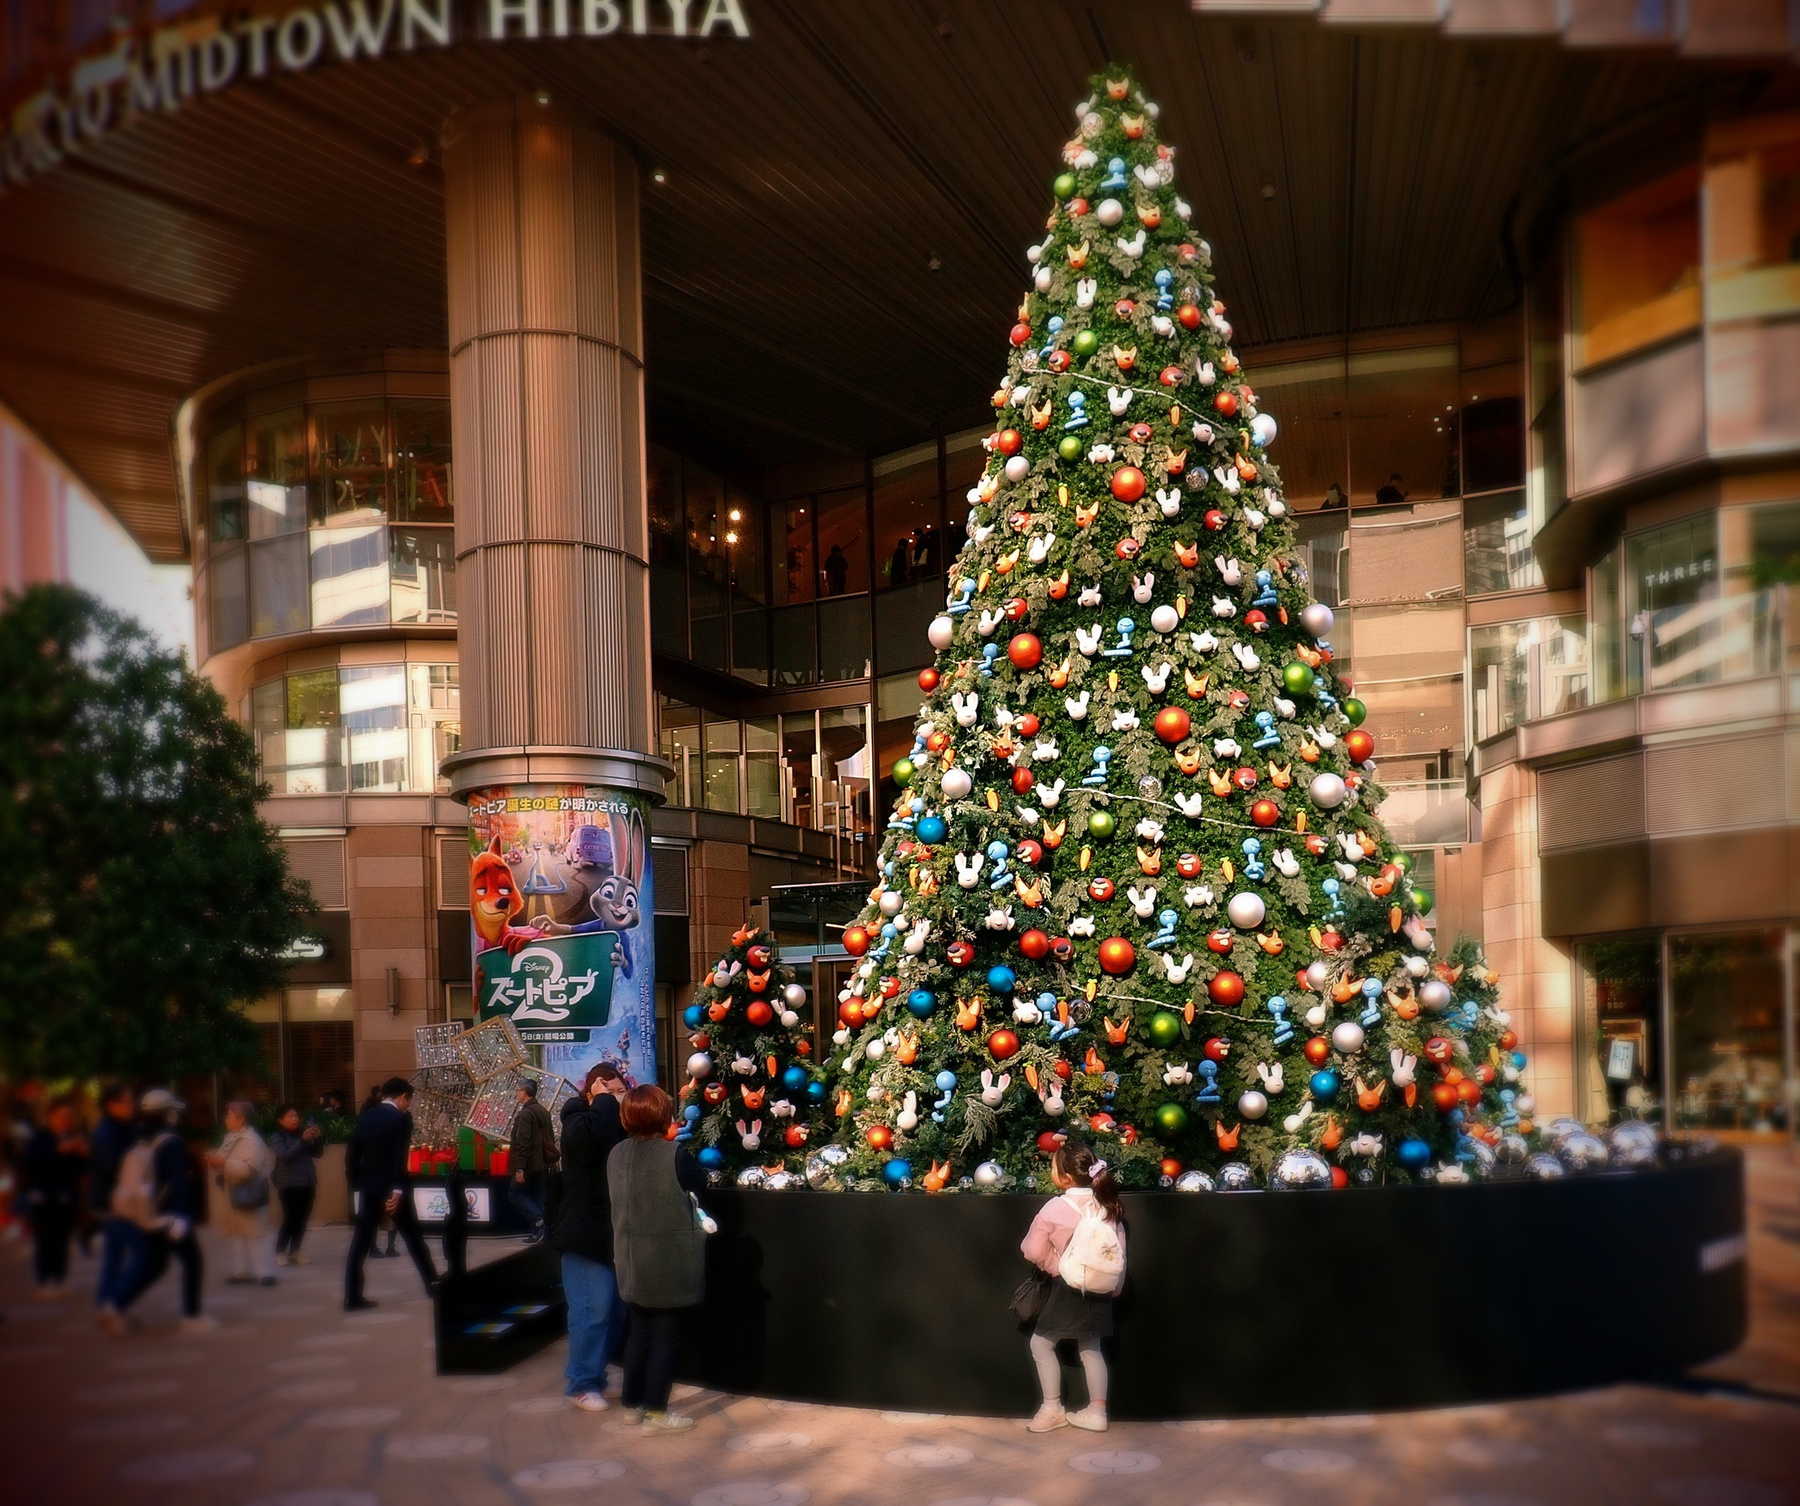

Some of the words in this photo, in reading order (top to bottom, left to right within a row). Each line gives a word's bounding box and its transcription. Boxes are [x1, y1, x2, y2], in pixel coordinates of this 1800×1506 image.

[128, 0, 450, 112] MIDTOWN
[491, 0, 750, 38] HIBIYA
[1645, 559, 1712, 587] THREE
[522, 961, 551, 974] Disney
[487, 968, 599, 1007] ズートピア
